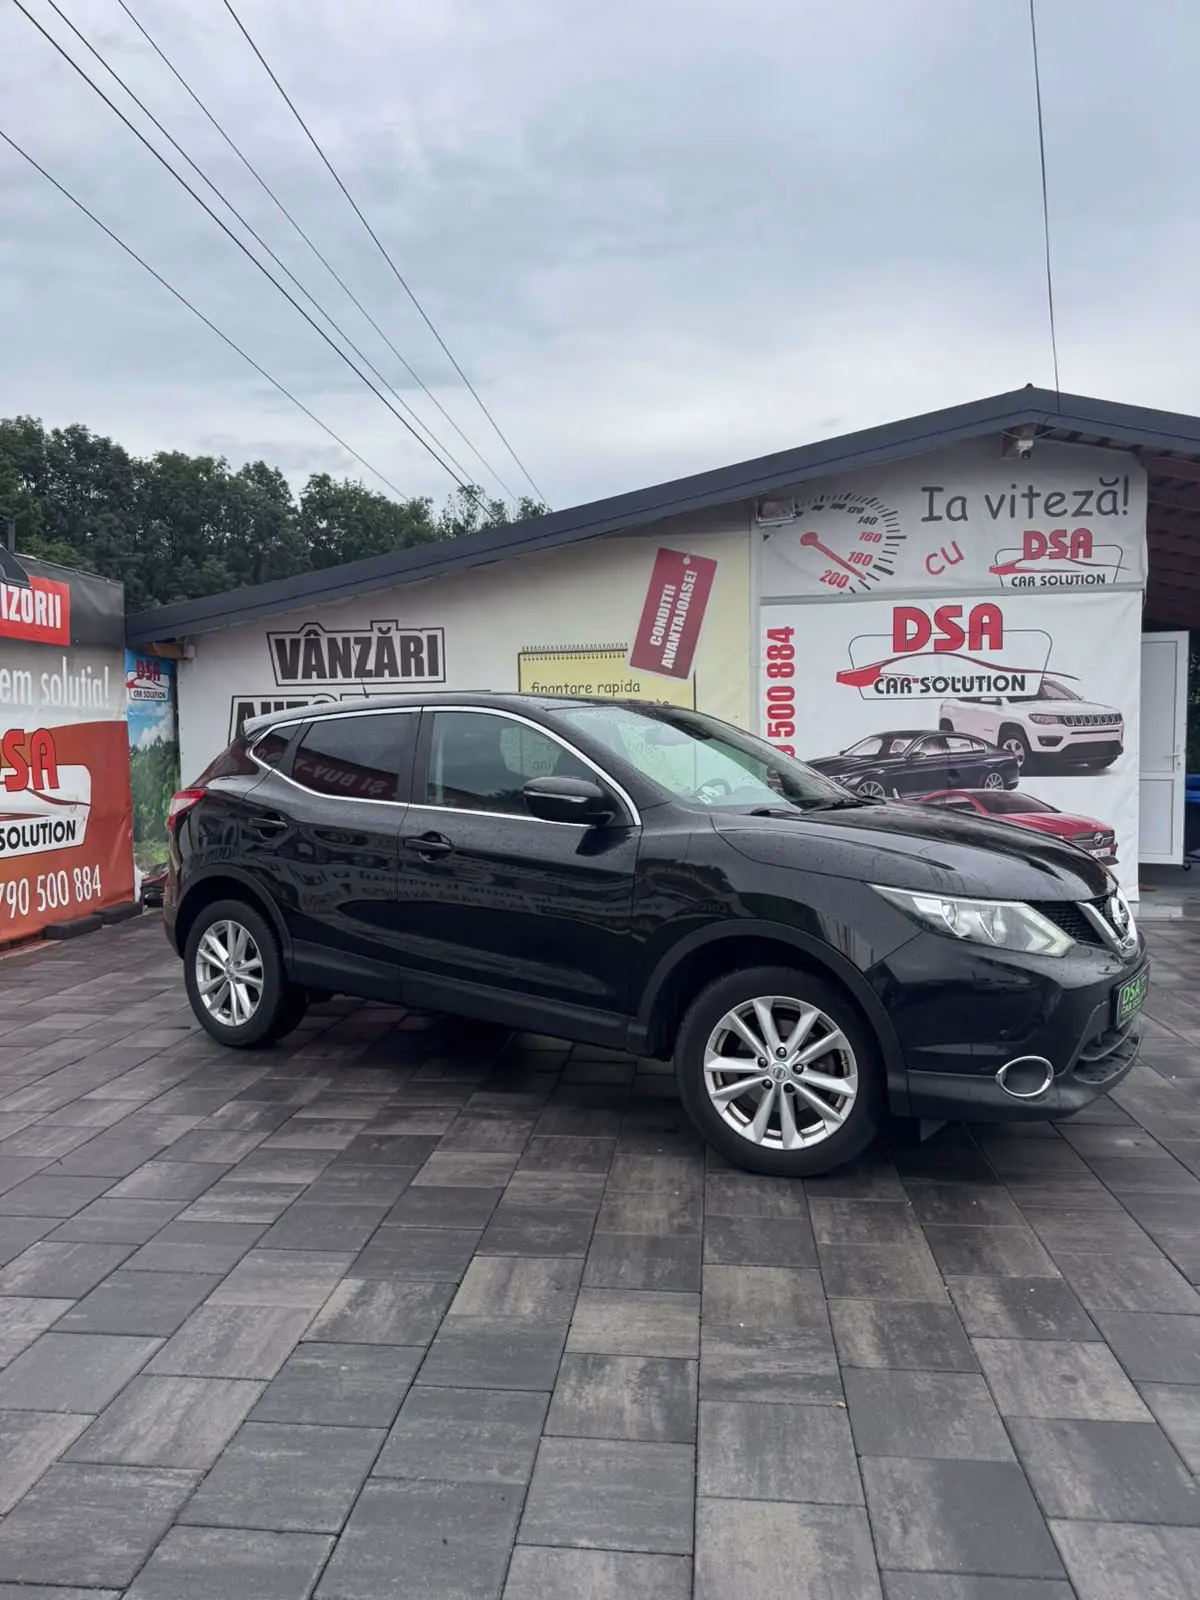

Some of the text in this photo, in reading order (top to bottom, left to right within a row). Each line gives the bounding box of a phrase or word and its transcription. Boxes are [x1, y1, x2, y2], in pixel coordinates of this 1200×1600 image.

[921, 475, 1130, 522] Ia viteză!
[858, 516, 878, 525] 140
[859, 532, 882, 543] 160
[847, 552, 874, 567] 180
[925, 540, 965, 575] cu
[1023, 527, 1093, 560] DSA
[819, 569, 850, 589] 200
[1011, 573, 1106, 587] CAR SOLUTION
[661, 569, 698, 669] AVANTAJOASE!
[892, 602, 1004, 653] DSA
[274, 626, 440, 680] VÂNZĂRI
[766, 626, 796, 678] 884
[136, 660, 160, 681] DSA
[597, 679, 641, 696] rapida
[874, 674, 1026, 695] CAR SOLUTION
[766, 685, 796, 737] 500
[0, 727, 60, 793] SA
[36, 869, 70, 912] 500
[73, 864, 102, 902] 884
